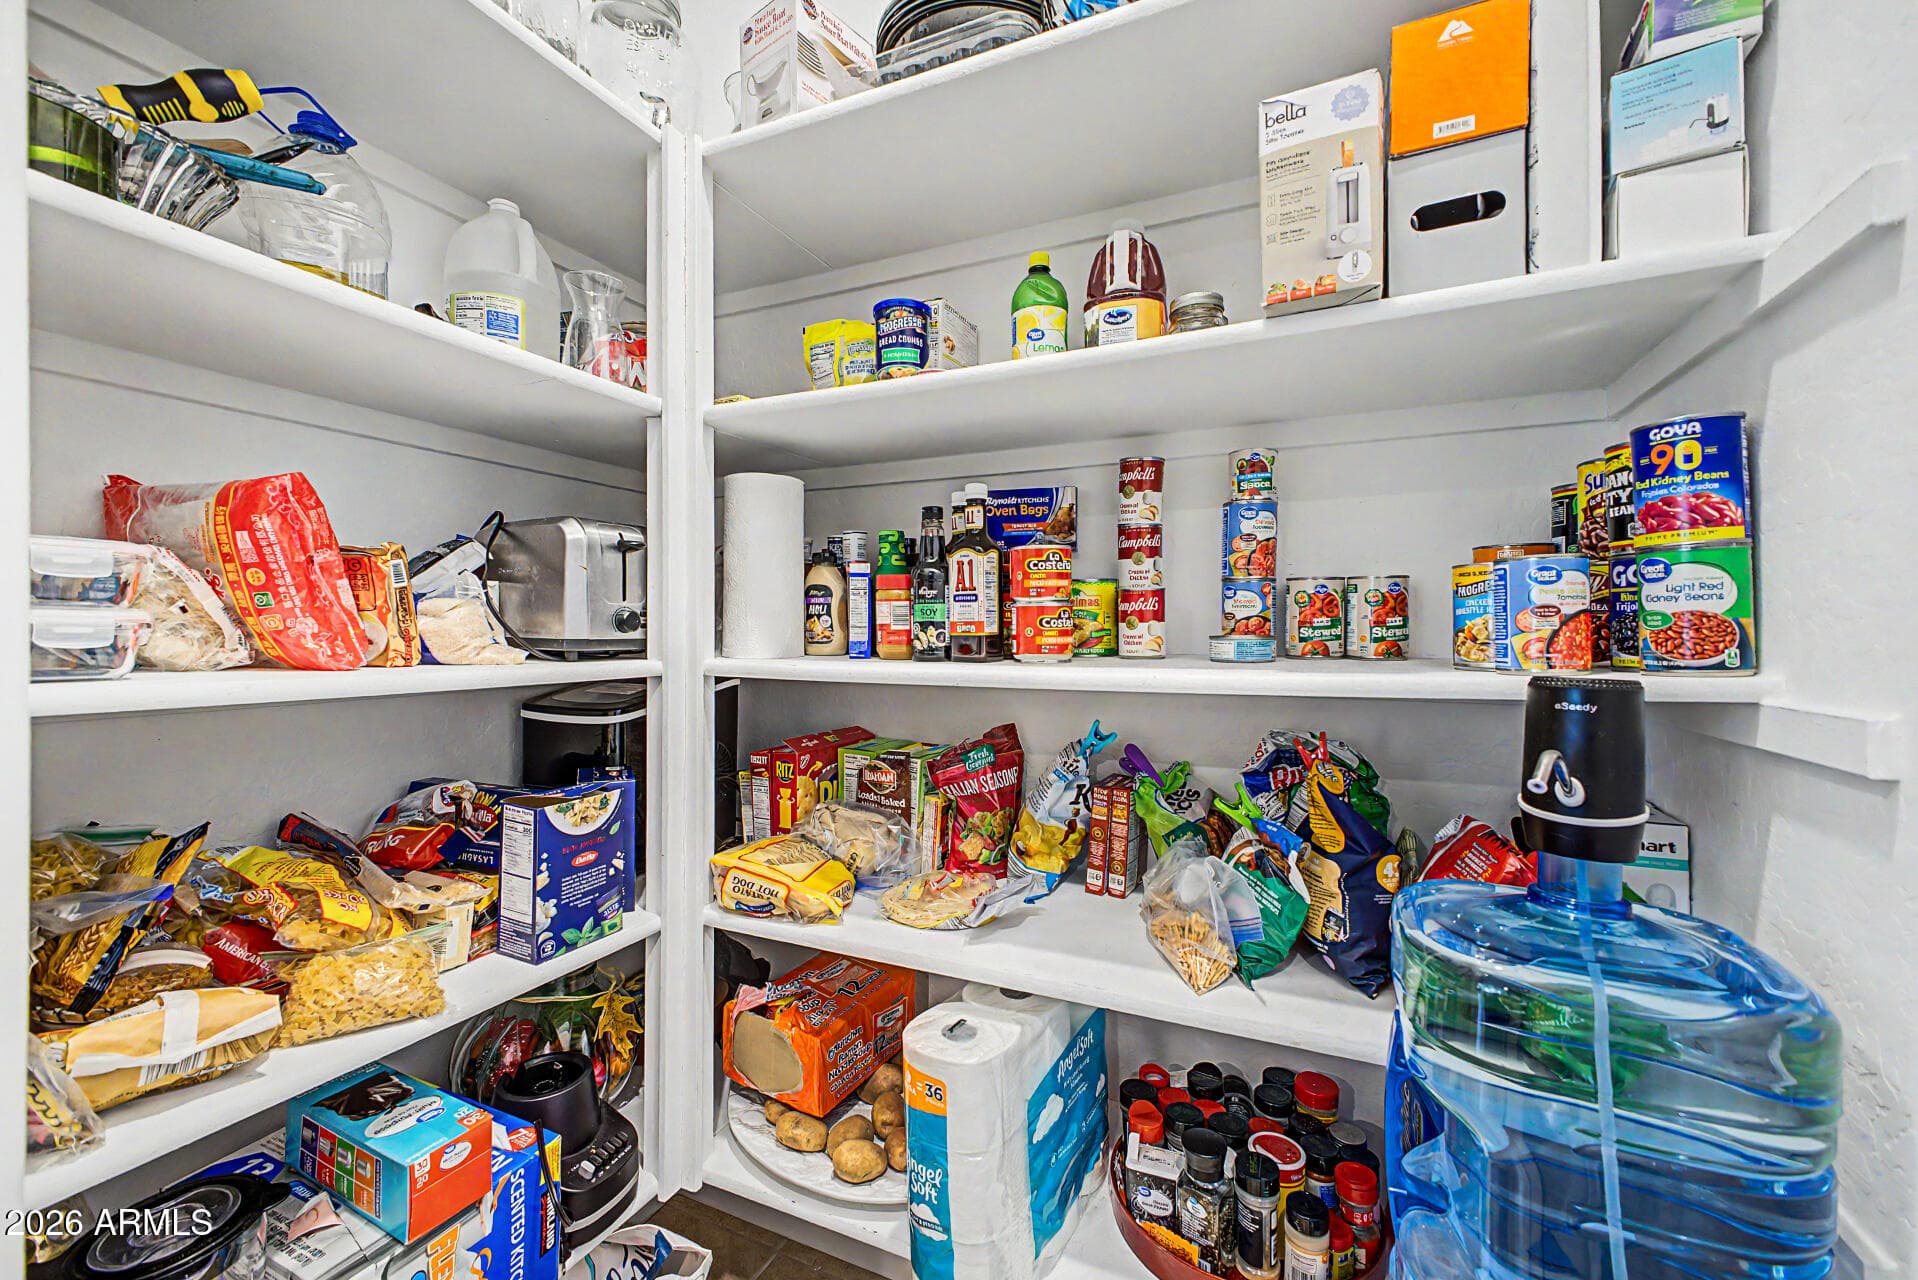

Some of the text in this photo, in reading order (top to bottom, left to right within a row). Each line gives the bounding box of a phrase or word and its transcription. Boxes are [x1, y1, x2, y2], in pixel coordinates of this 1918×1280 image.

[1264, 105, 1307, 130] bella
[879, 335, 897, 347] BREAD
[1649, 421, 1703, 441] GOYA
[1650, 440, 1703, 475] 90
[1240, 481, 1271, 490] Sauce
[1651, 473, 1691, 487] Kidney
[1694, 470, 1730, 482] Beans
[1669, 482, 1720, 494] Colorados
[986, 504, 1049, 518] Oven Bags
[1118, 533, 1161, 549] Campbell's
[1050, 553, 1060, 561] La
[956, 558, 977, 592] A1
[1665, 581, 1724, 594] Light Red
[1119, 597, 1158, 612] ampbell's
[1684, 591, 1725, 602] Beans
[920, 608, 938, 616] SOY
[1061, 610, 1069, 618] La
[1300, 626, 1341, 638] Stewed
[1554, 701, 1598, 714] eSeedy
[776, 761, 794, 778] RITZ
[940, 778, 980, 797] ITALIAN
[880, 792, 906, 807] Baked
[732, 876, 780, 898] HOT DOG
[213, 937, 260, 967] AMERICAN
[1057, 1037, 1080, 1084] Angel
[1079, 1027, 1094, 1056] Soft
[924, 1083, 943, 1102] 36
[910, 1174, 939, 1204] Soft
[509, 1167, 525, 1245] SCENTED
